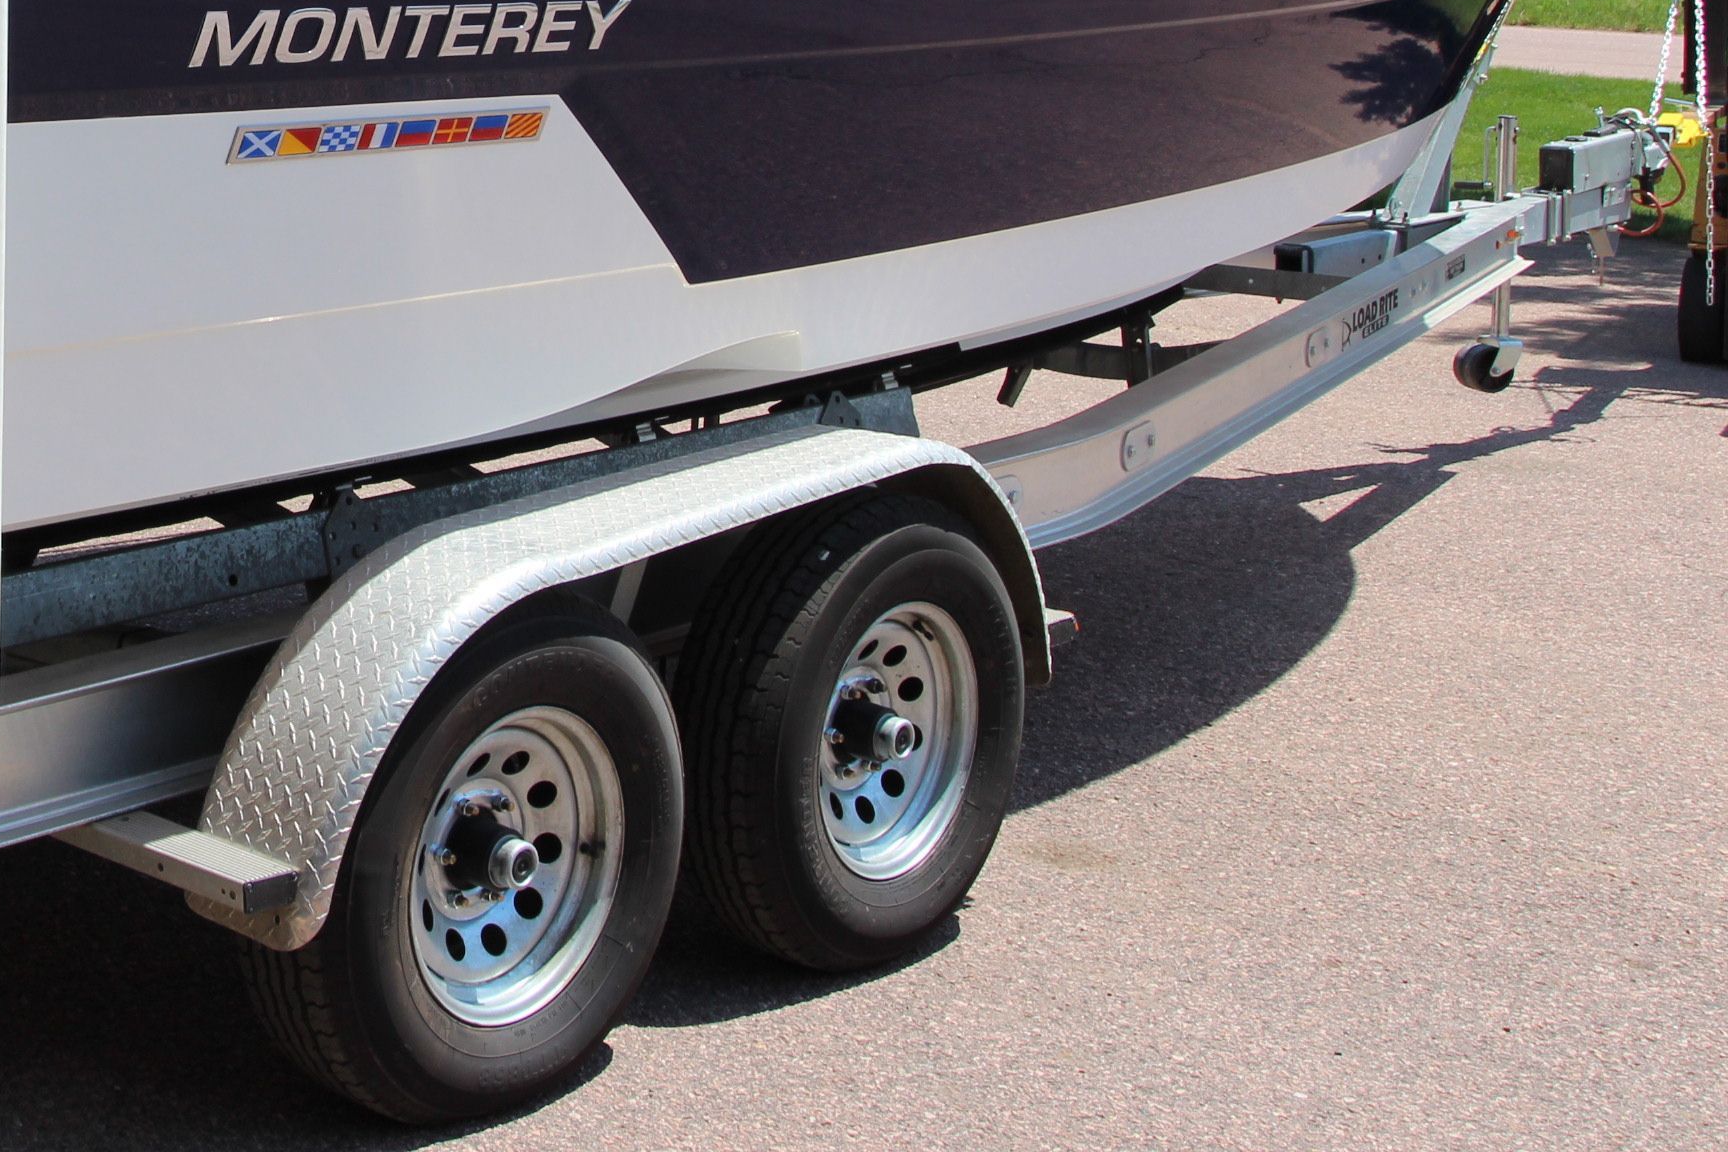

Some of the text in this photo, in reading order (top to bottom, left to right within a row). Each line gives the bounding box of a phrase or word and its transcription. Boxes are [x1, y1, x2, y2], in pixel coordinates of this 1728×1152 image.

[187, 0, 632, 68] MONTEREY
[1352, 288, 1399, 333] LOAD RITE
